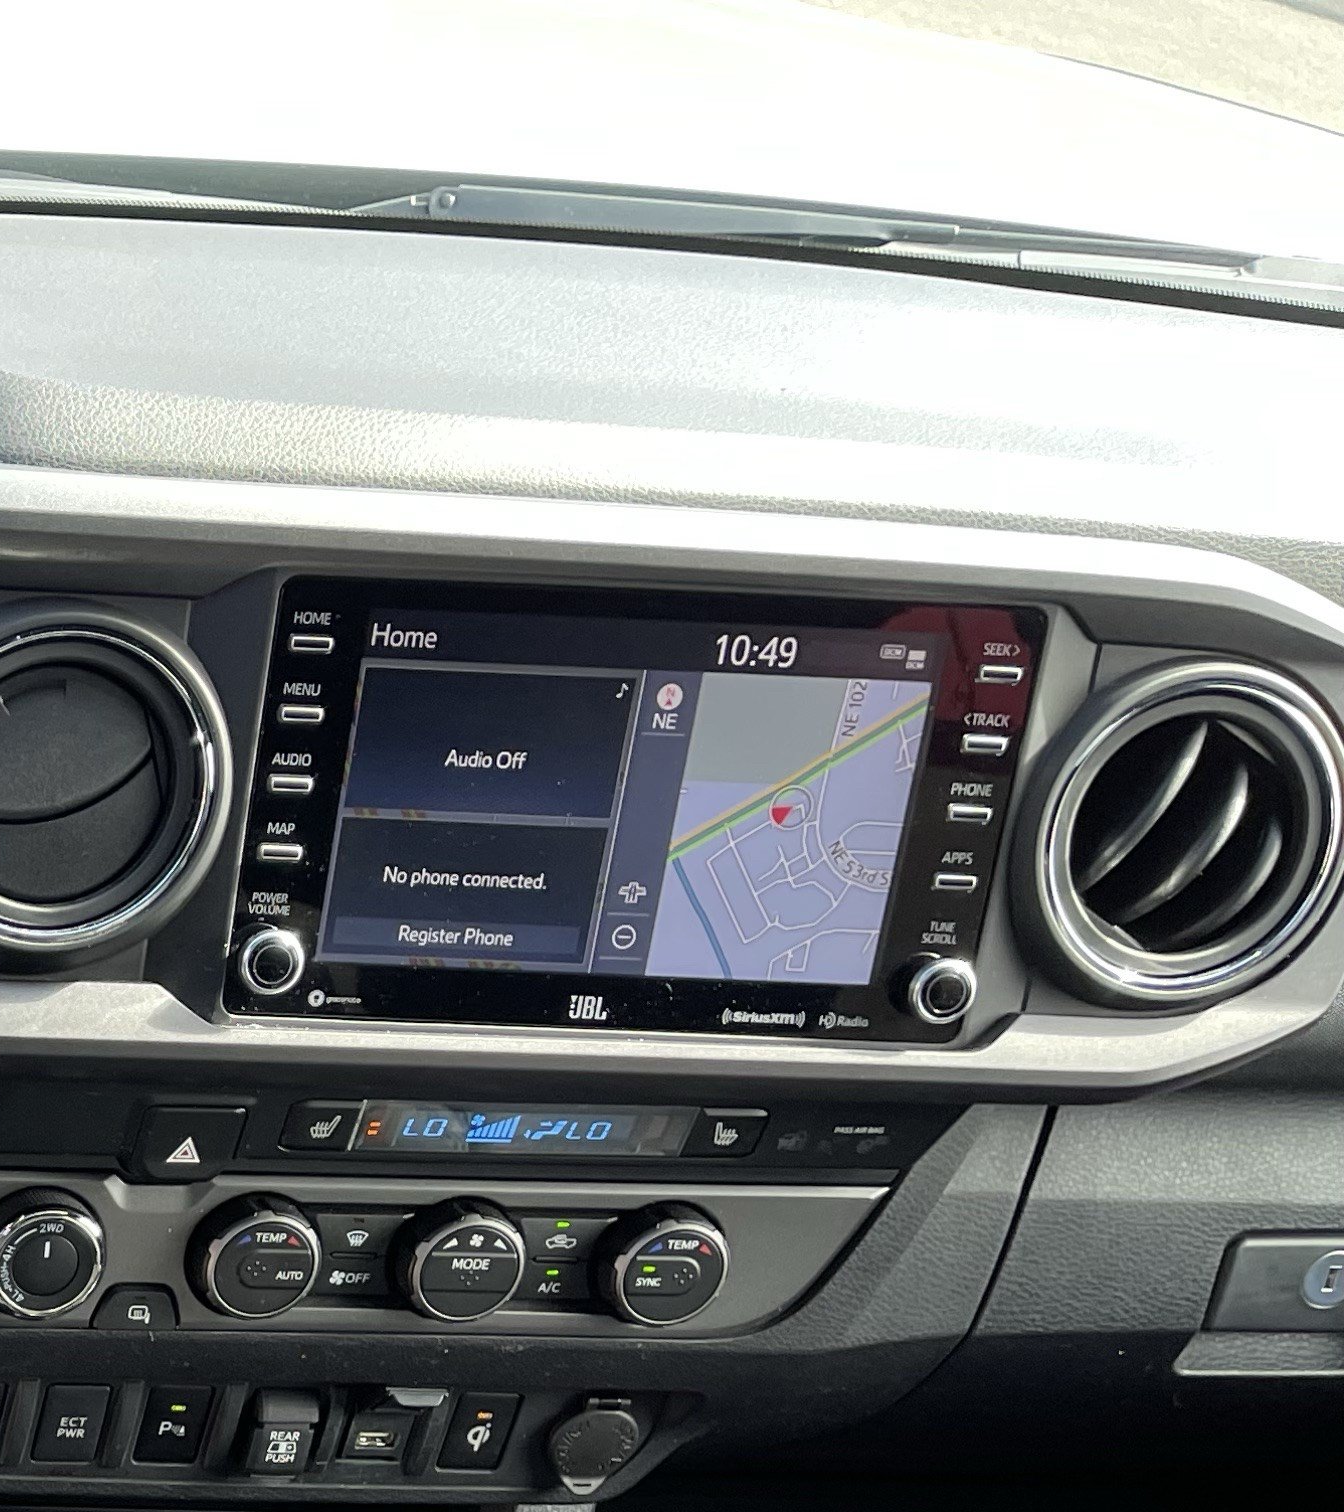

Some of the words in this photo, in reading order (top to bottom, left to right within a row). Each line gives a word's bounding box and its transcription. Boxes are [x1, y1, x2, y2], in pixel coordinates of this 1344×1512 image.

[294, 612, 332, 626] HOME
[370, 622, 438, 650] Home
[715, 634, 798, 668] 10:49
[283, 682, 321, 696] MENU
[652, 712, 678, 730] NE
[842, 716, 860, 738] NE
[272, 752, 312, 767] AUDIO
[444, 748, 493, 770] Audio
[496, 752, 527, 770] Off
[950, 784, 994, 797] PHONE
[267, 822, 296, 836] MAP
[828, 840, 850, 868] NE
[941, 852, 973, 865] APPS
[382, 866, 408, 885] No
[410, 867, 459, 888] phone
[462, 870, 547, 890] connected.
[252, 892, 288, 904] POWER
[248, 901, 290, 916] VOLUME
[928, 920, 957, 934] TUNE
[398, 925, 460, 947] Register
[464, 928, 514, 947] Phone
[920, 932, 958, 946] SCROLL
[568, 994, 608, 1020] JBL
[837, 1015, 869, 1028] Radio
[402, 1118, 448, 1138] LO
[565, 1121, 612, 1141] LO
[39, 1222, 64, 1234] 2WD
[256, 1232, 287, 1244] TEMP
[667, 1240, 700, 1252] TEMP
[452, 1258, 491, 1272] MODE
[276, 1270, 304, 1282] AUTO
[345, 1272, 371, 1284] OFF
[635, 1277, 662, 1288] SYNC
[538, 1280, 561, 1294] A/C
[60, 1416, 88, 1428] ECT
[56, 1428, 85, 1439] PWR
[270, 1430, 300, 1442] REAR
[265, 1454, 295, 1464] PUSH
